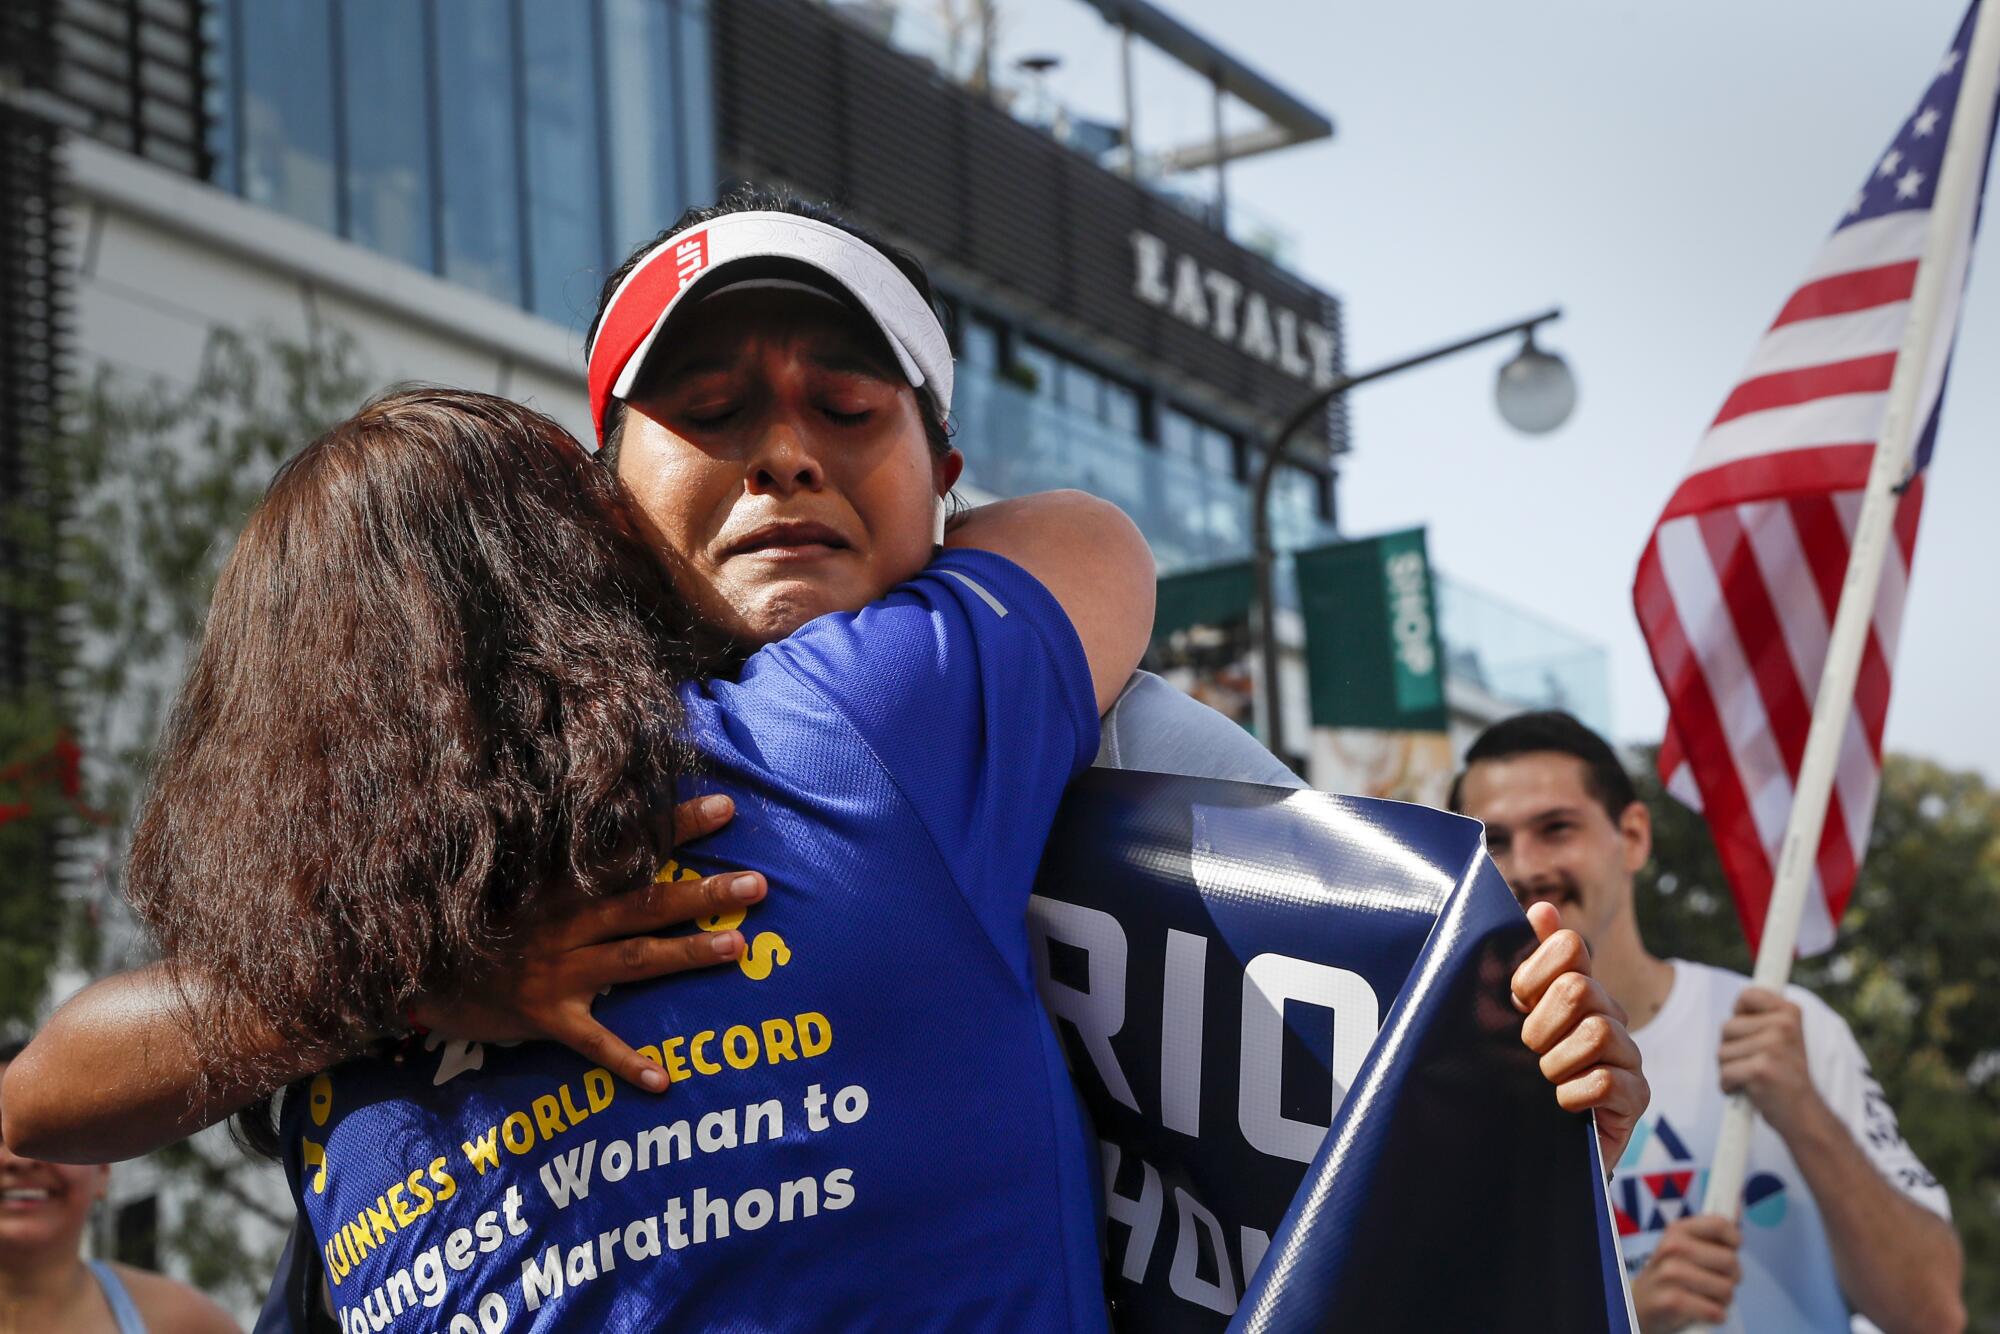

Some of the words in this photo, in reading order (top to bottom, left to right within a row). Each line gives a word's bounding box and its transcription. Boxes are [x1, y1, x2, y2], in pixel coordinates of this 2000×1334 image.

[1131, 230, 1341, 389] EATALY
[1386, 551, 1435, 675] SHOP
[461, 1067, 615, 1175] WORLD
[539, 1099, 783, 1212] Woman
[803, 1083, 869, 1132] to
[521, 1168, 856, 1312] Marathons
